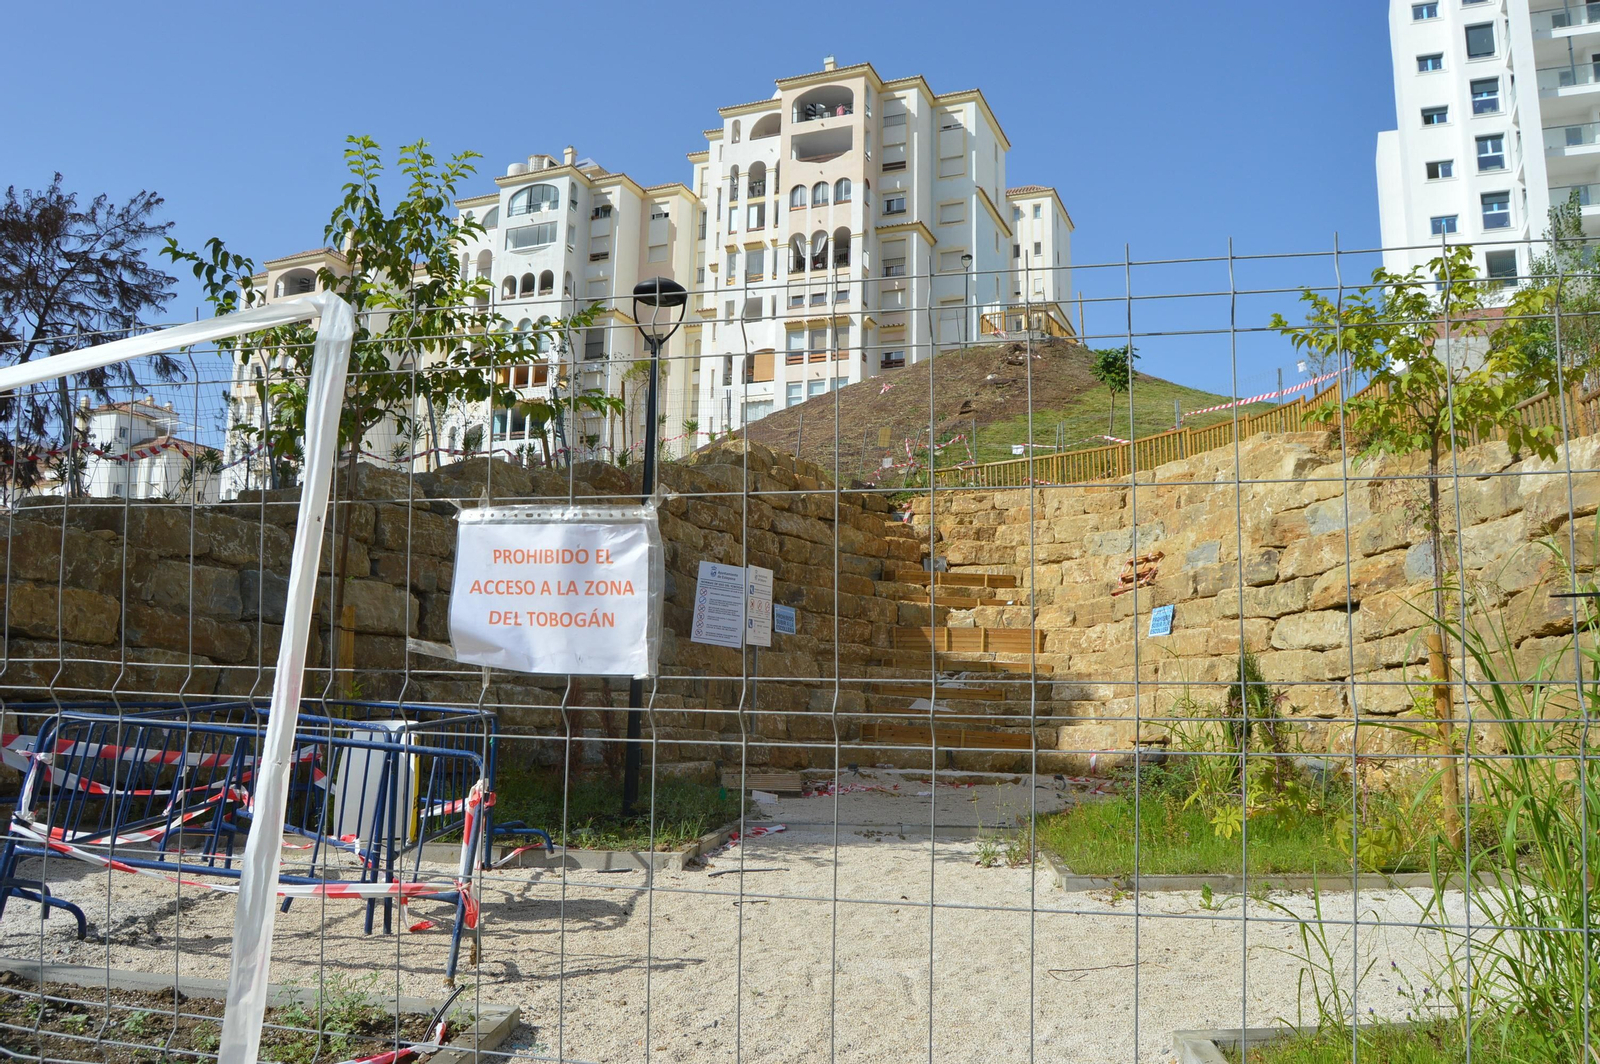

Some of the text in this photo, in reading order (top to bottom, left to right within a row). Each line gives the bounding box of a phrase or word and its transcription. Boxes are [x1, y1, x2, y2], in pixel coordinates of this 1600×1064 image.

[493, 548, 614, 564] PROHIBIDO EL
[469, 580, 635, 596] ACCESO A LA ZONA
[488, 608, 615, 628] DEL TOBOGÁN
